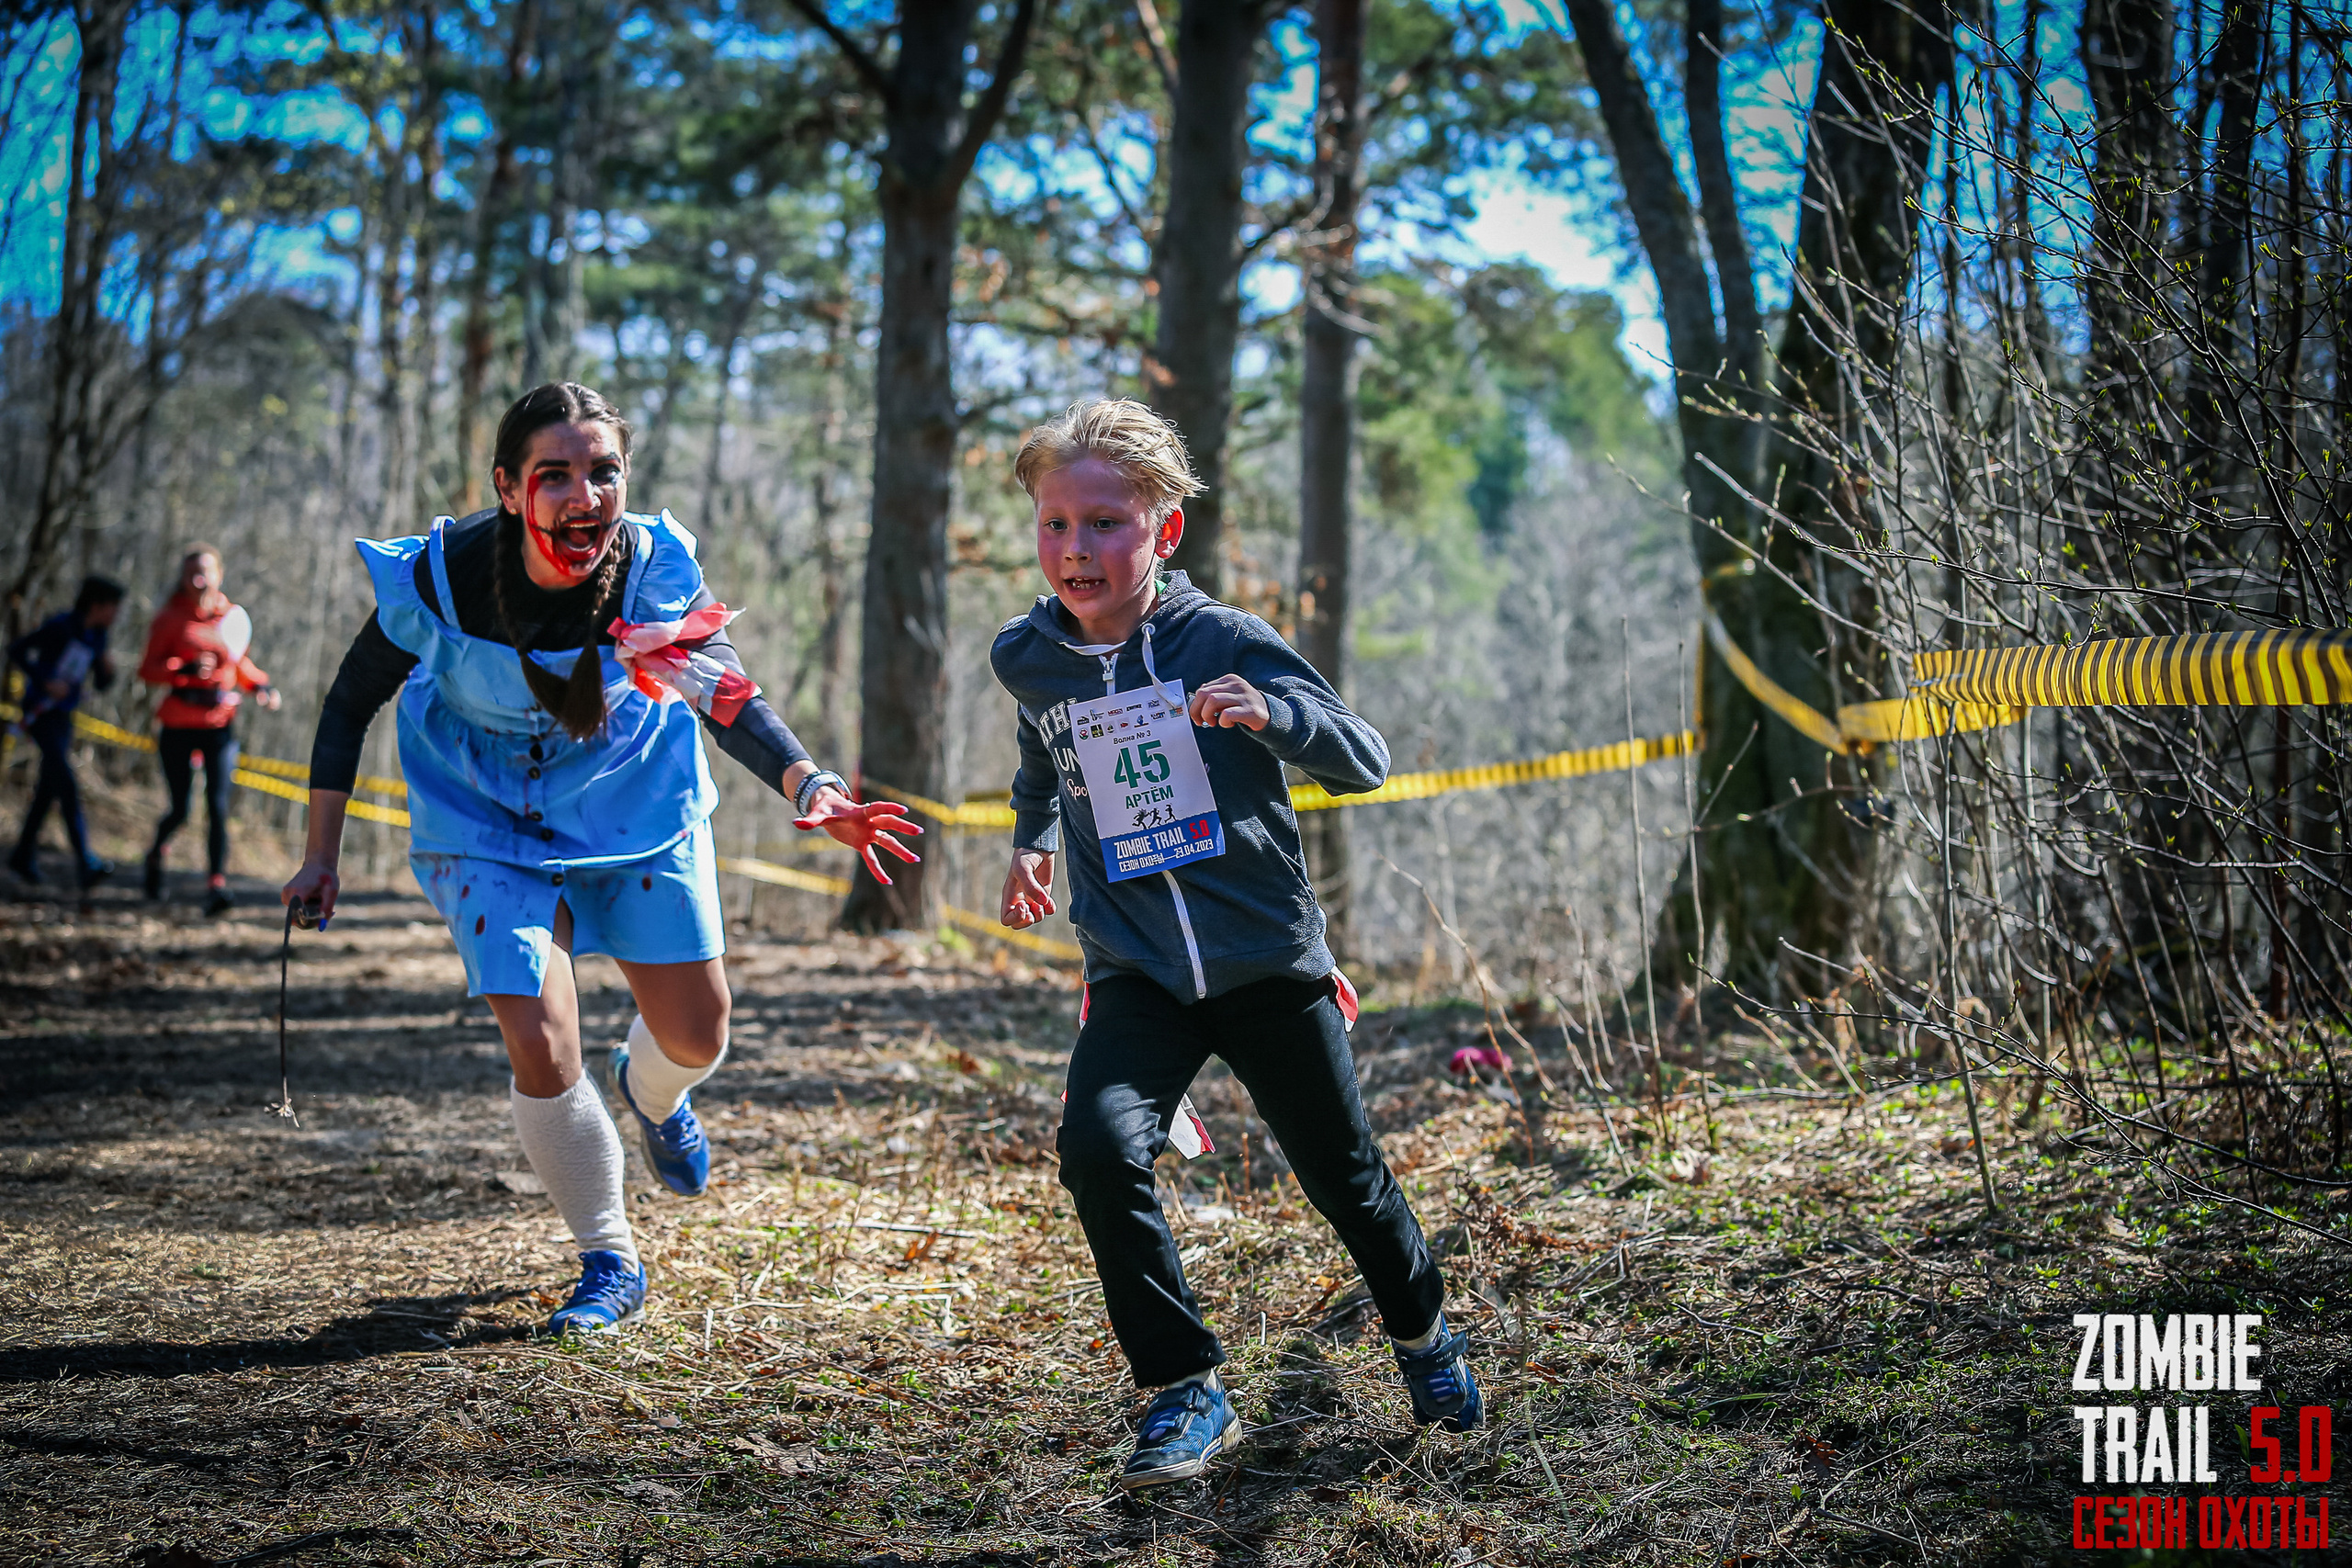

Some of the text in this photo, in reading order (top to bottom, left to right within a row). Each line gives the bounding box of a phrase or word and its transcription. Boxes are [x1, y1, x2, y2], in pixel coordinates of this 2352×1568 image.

[1114, 734, 1136, 745] Волна
[1114, 739, 1171, 789] 45
[1125, 784, 1174, 809] АРТЁМ
[1114, 819, 1210, 860] ZOMBIE TRAIL 5.0
[1173, 838, 1215, 859] 23.04.2023
[1118, 859, 1140, 873] СЕЗОН
